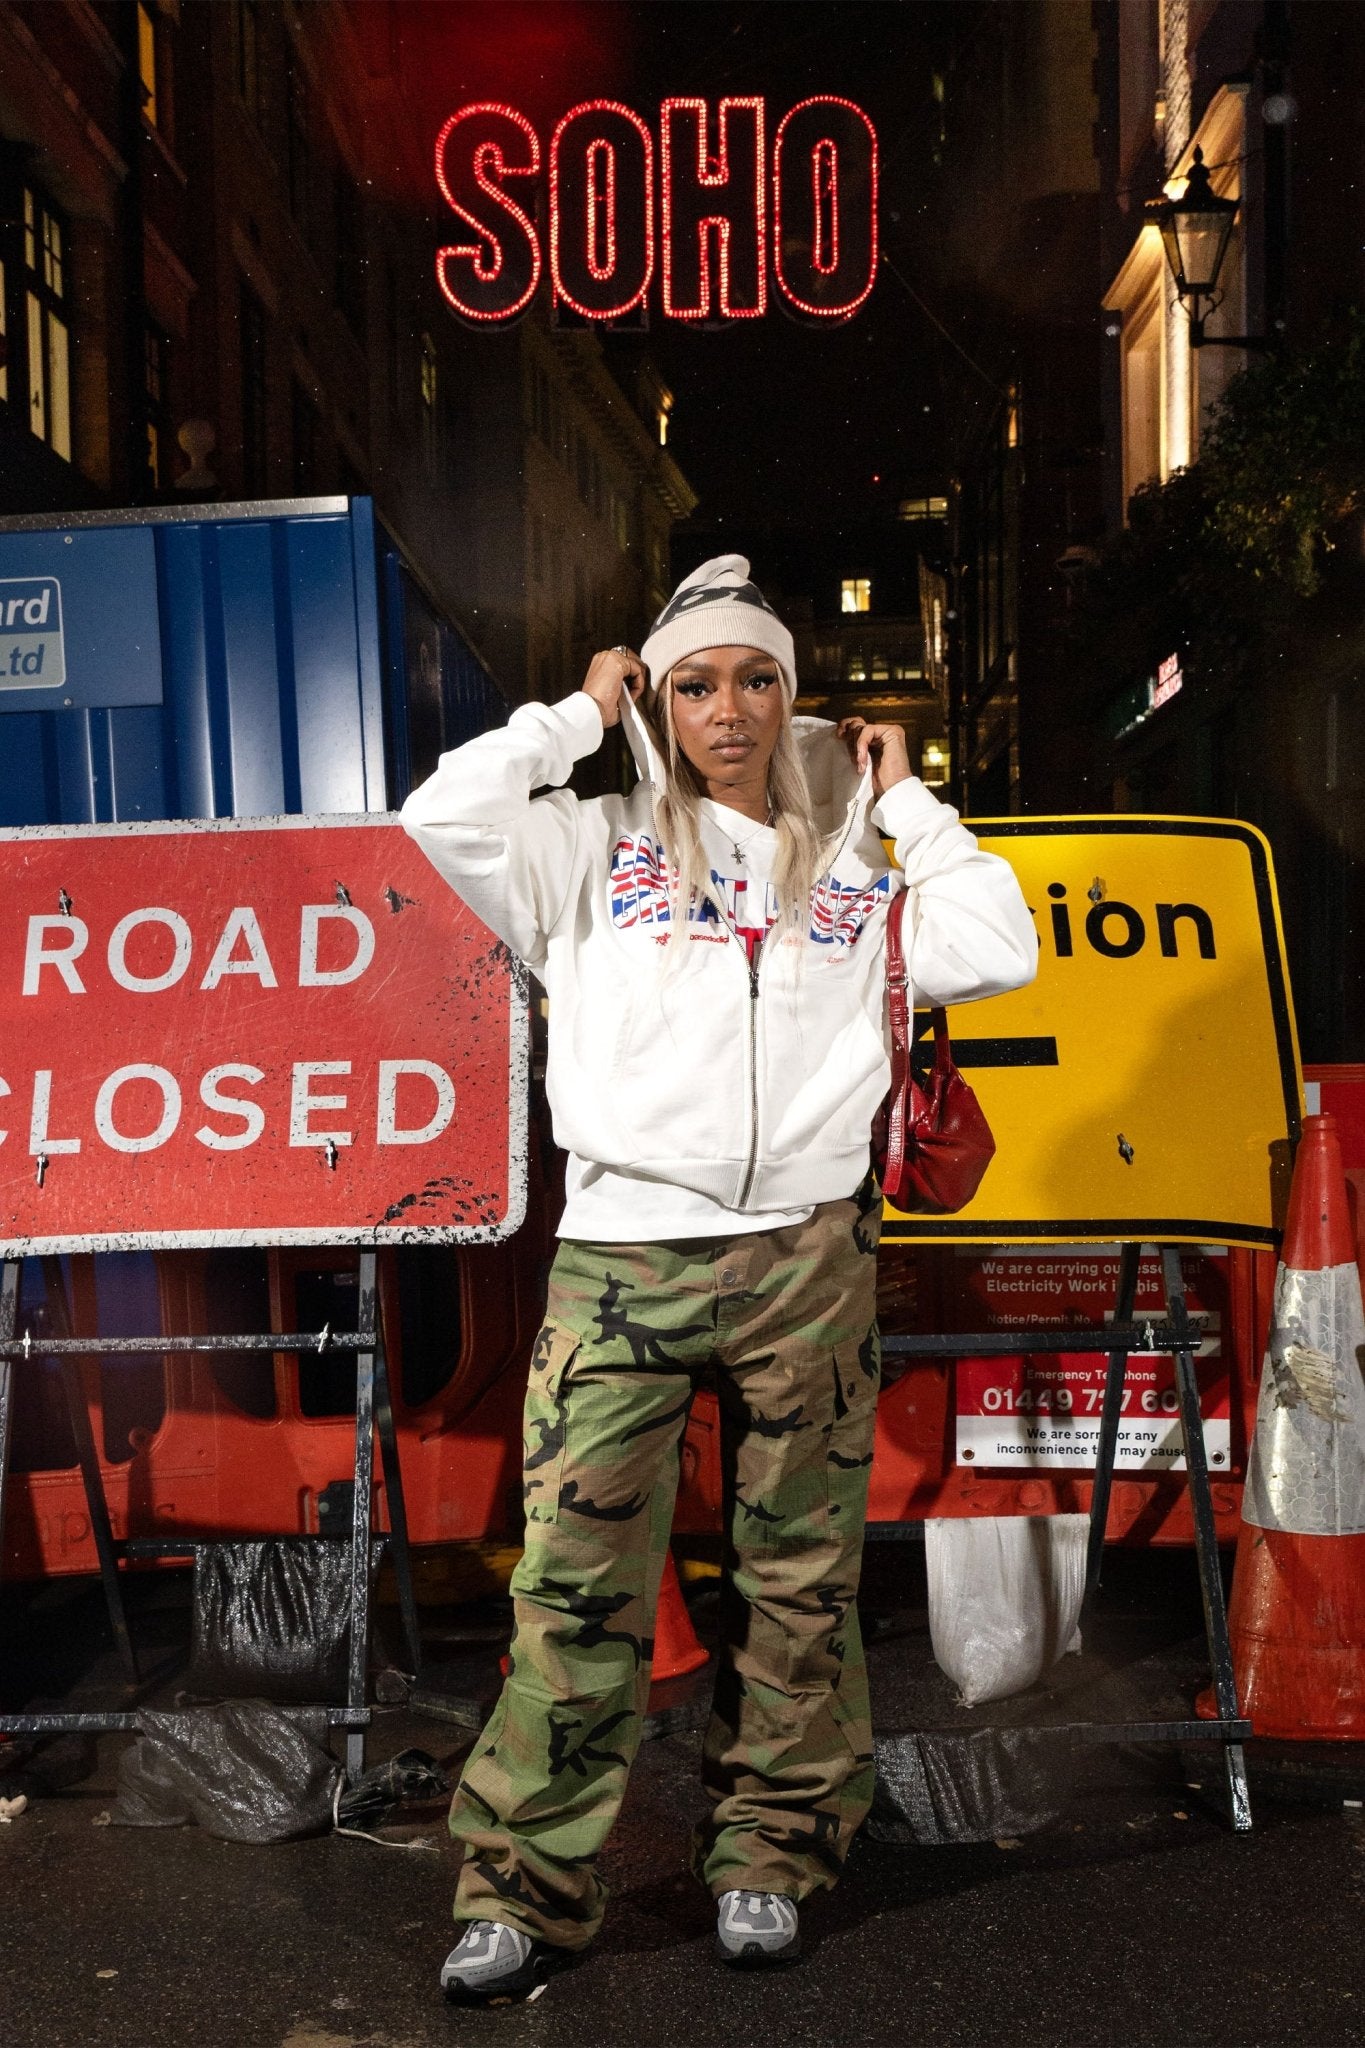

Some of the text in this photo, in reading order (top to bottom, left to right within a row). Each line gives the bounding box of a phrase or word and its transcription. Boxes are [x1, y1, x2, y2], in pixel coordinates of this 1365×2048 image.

[434, 95, 879, 320] SOHO
[0, 588, 51, 626] rd
[0, 643, 45, 677] td
[1028, 882, 1217, 960] ion
[22, 904, 376, 996] ROAD
[0, 1059, 456, 1155] LOSED
[981, 1262, 1004, 1275] We
[1008, 1264, 1033, 1275] are
[1036, 1261, 1099, 1277] carrying
[986, 1279, 1063, 1294] Electricity
[1067, 1279, 1108, 1292] Work
[1136, 1279, 1160, 1292] his
[1027, 1369, 1157, 1382] Emergency Tehone
[983, 1387, 1073, 1411] 01449
[1026, 1428, 1158, 1442] We are sorr or any
[997, 1443, 1088, 1455] inconvenience
[1120, 1446, 1147, 1458] may
